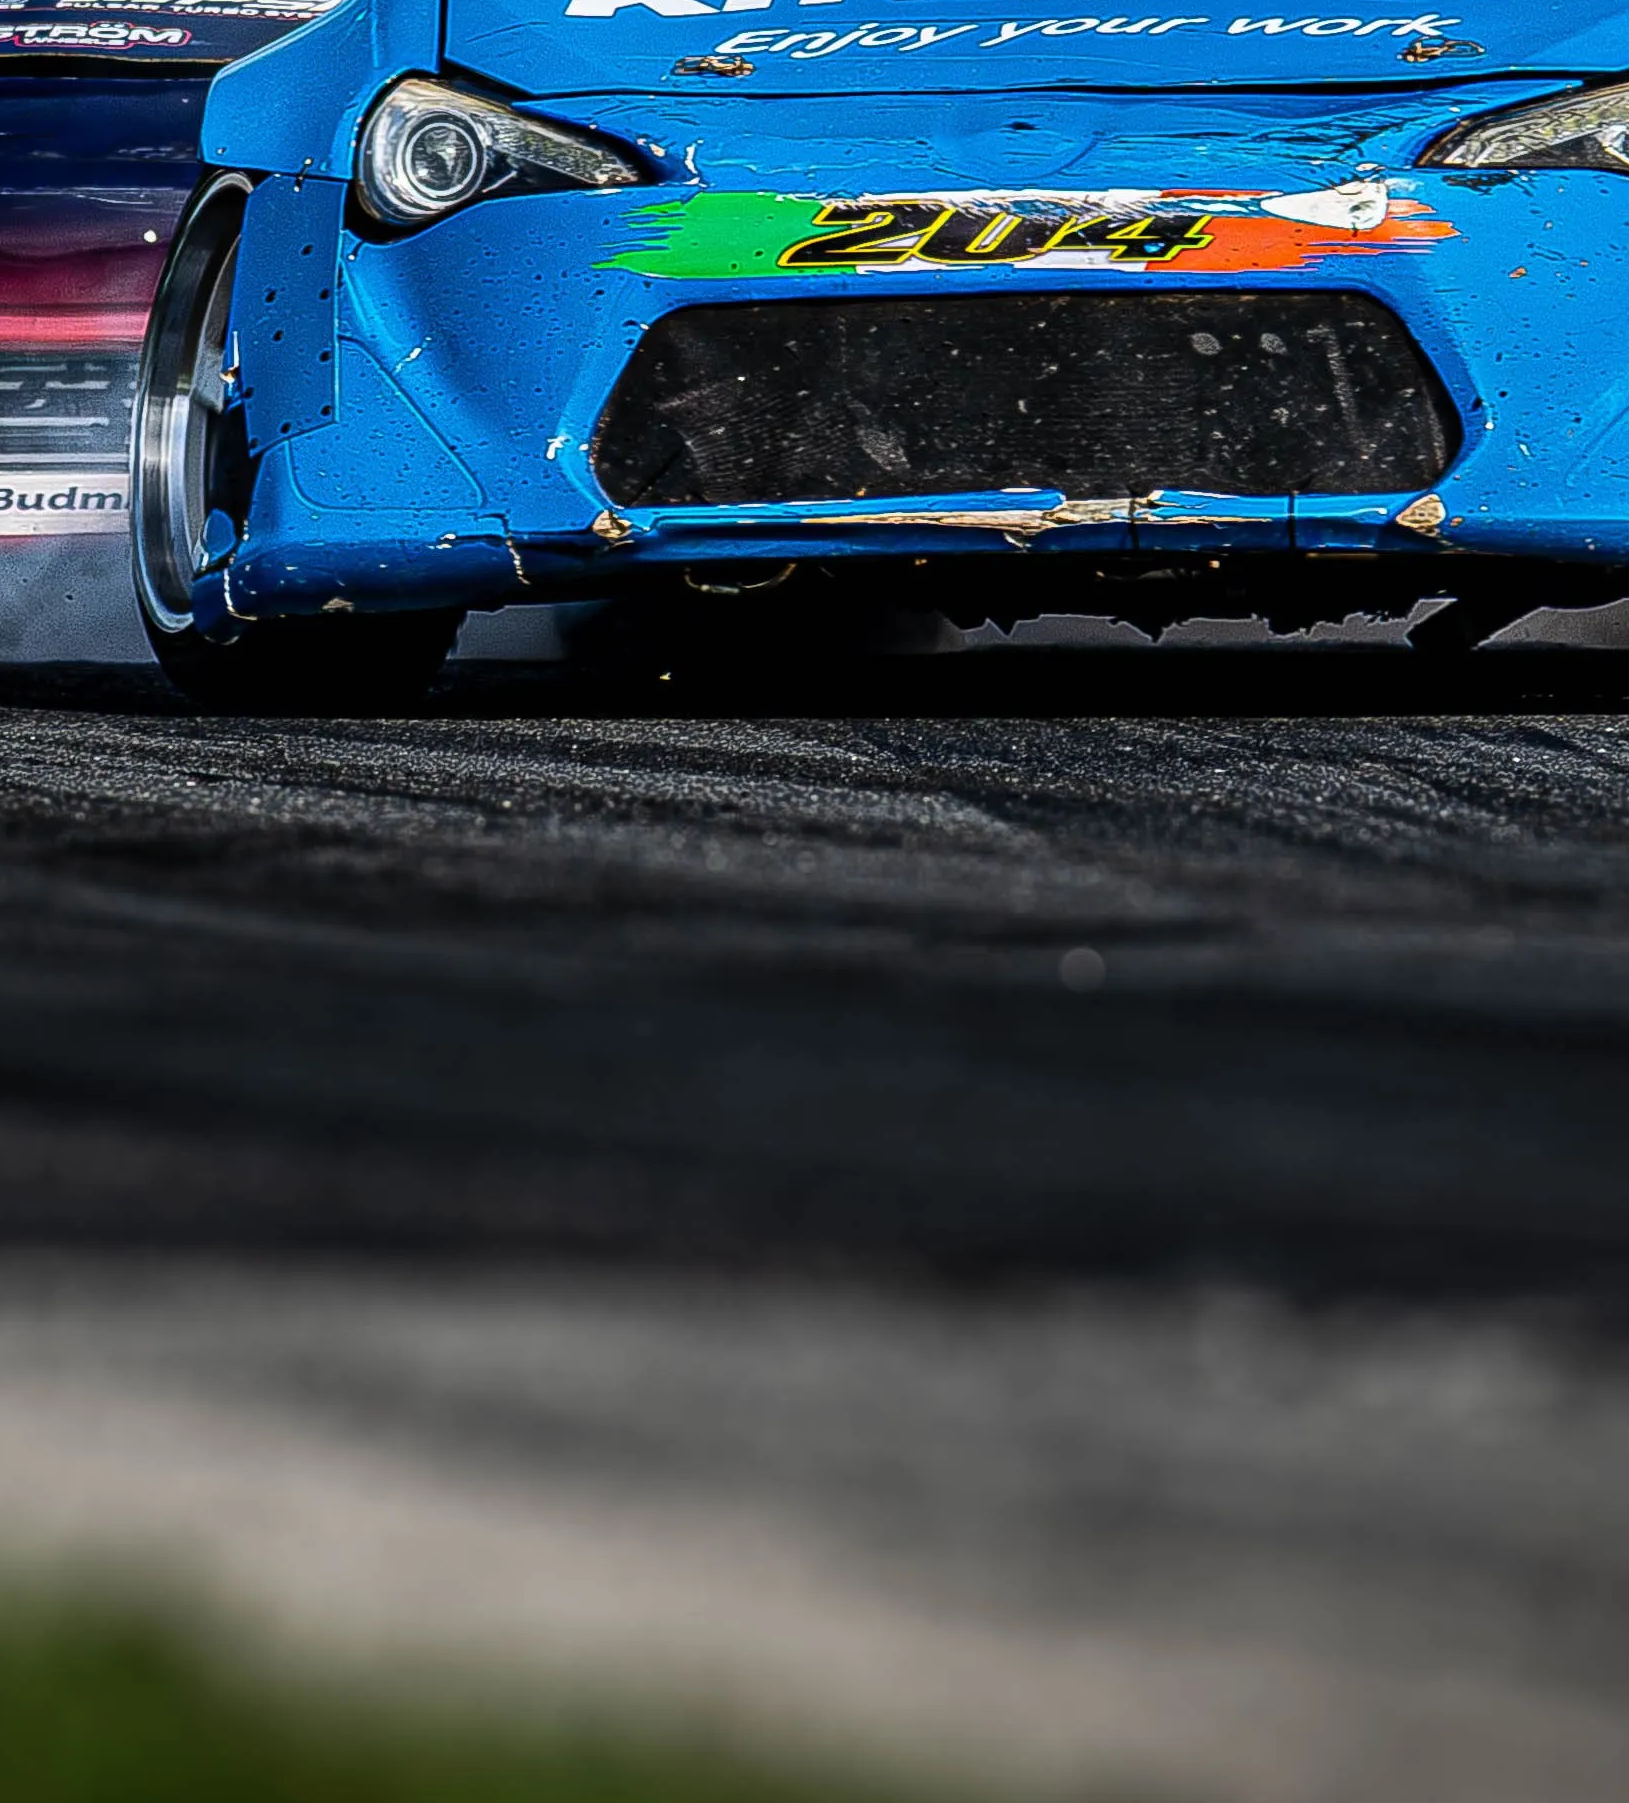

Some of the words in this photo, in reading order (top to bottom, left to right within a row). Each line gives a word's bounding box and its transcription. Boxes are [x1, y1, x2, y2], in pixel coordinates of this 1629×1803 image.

[713, 19, 979, 59] Enjoy
[980, 15, 1210, 48] your
[1228, 13, 1462, 38] work
[774, 199, 1217, 268] 204
